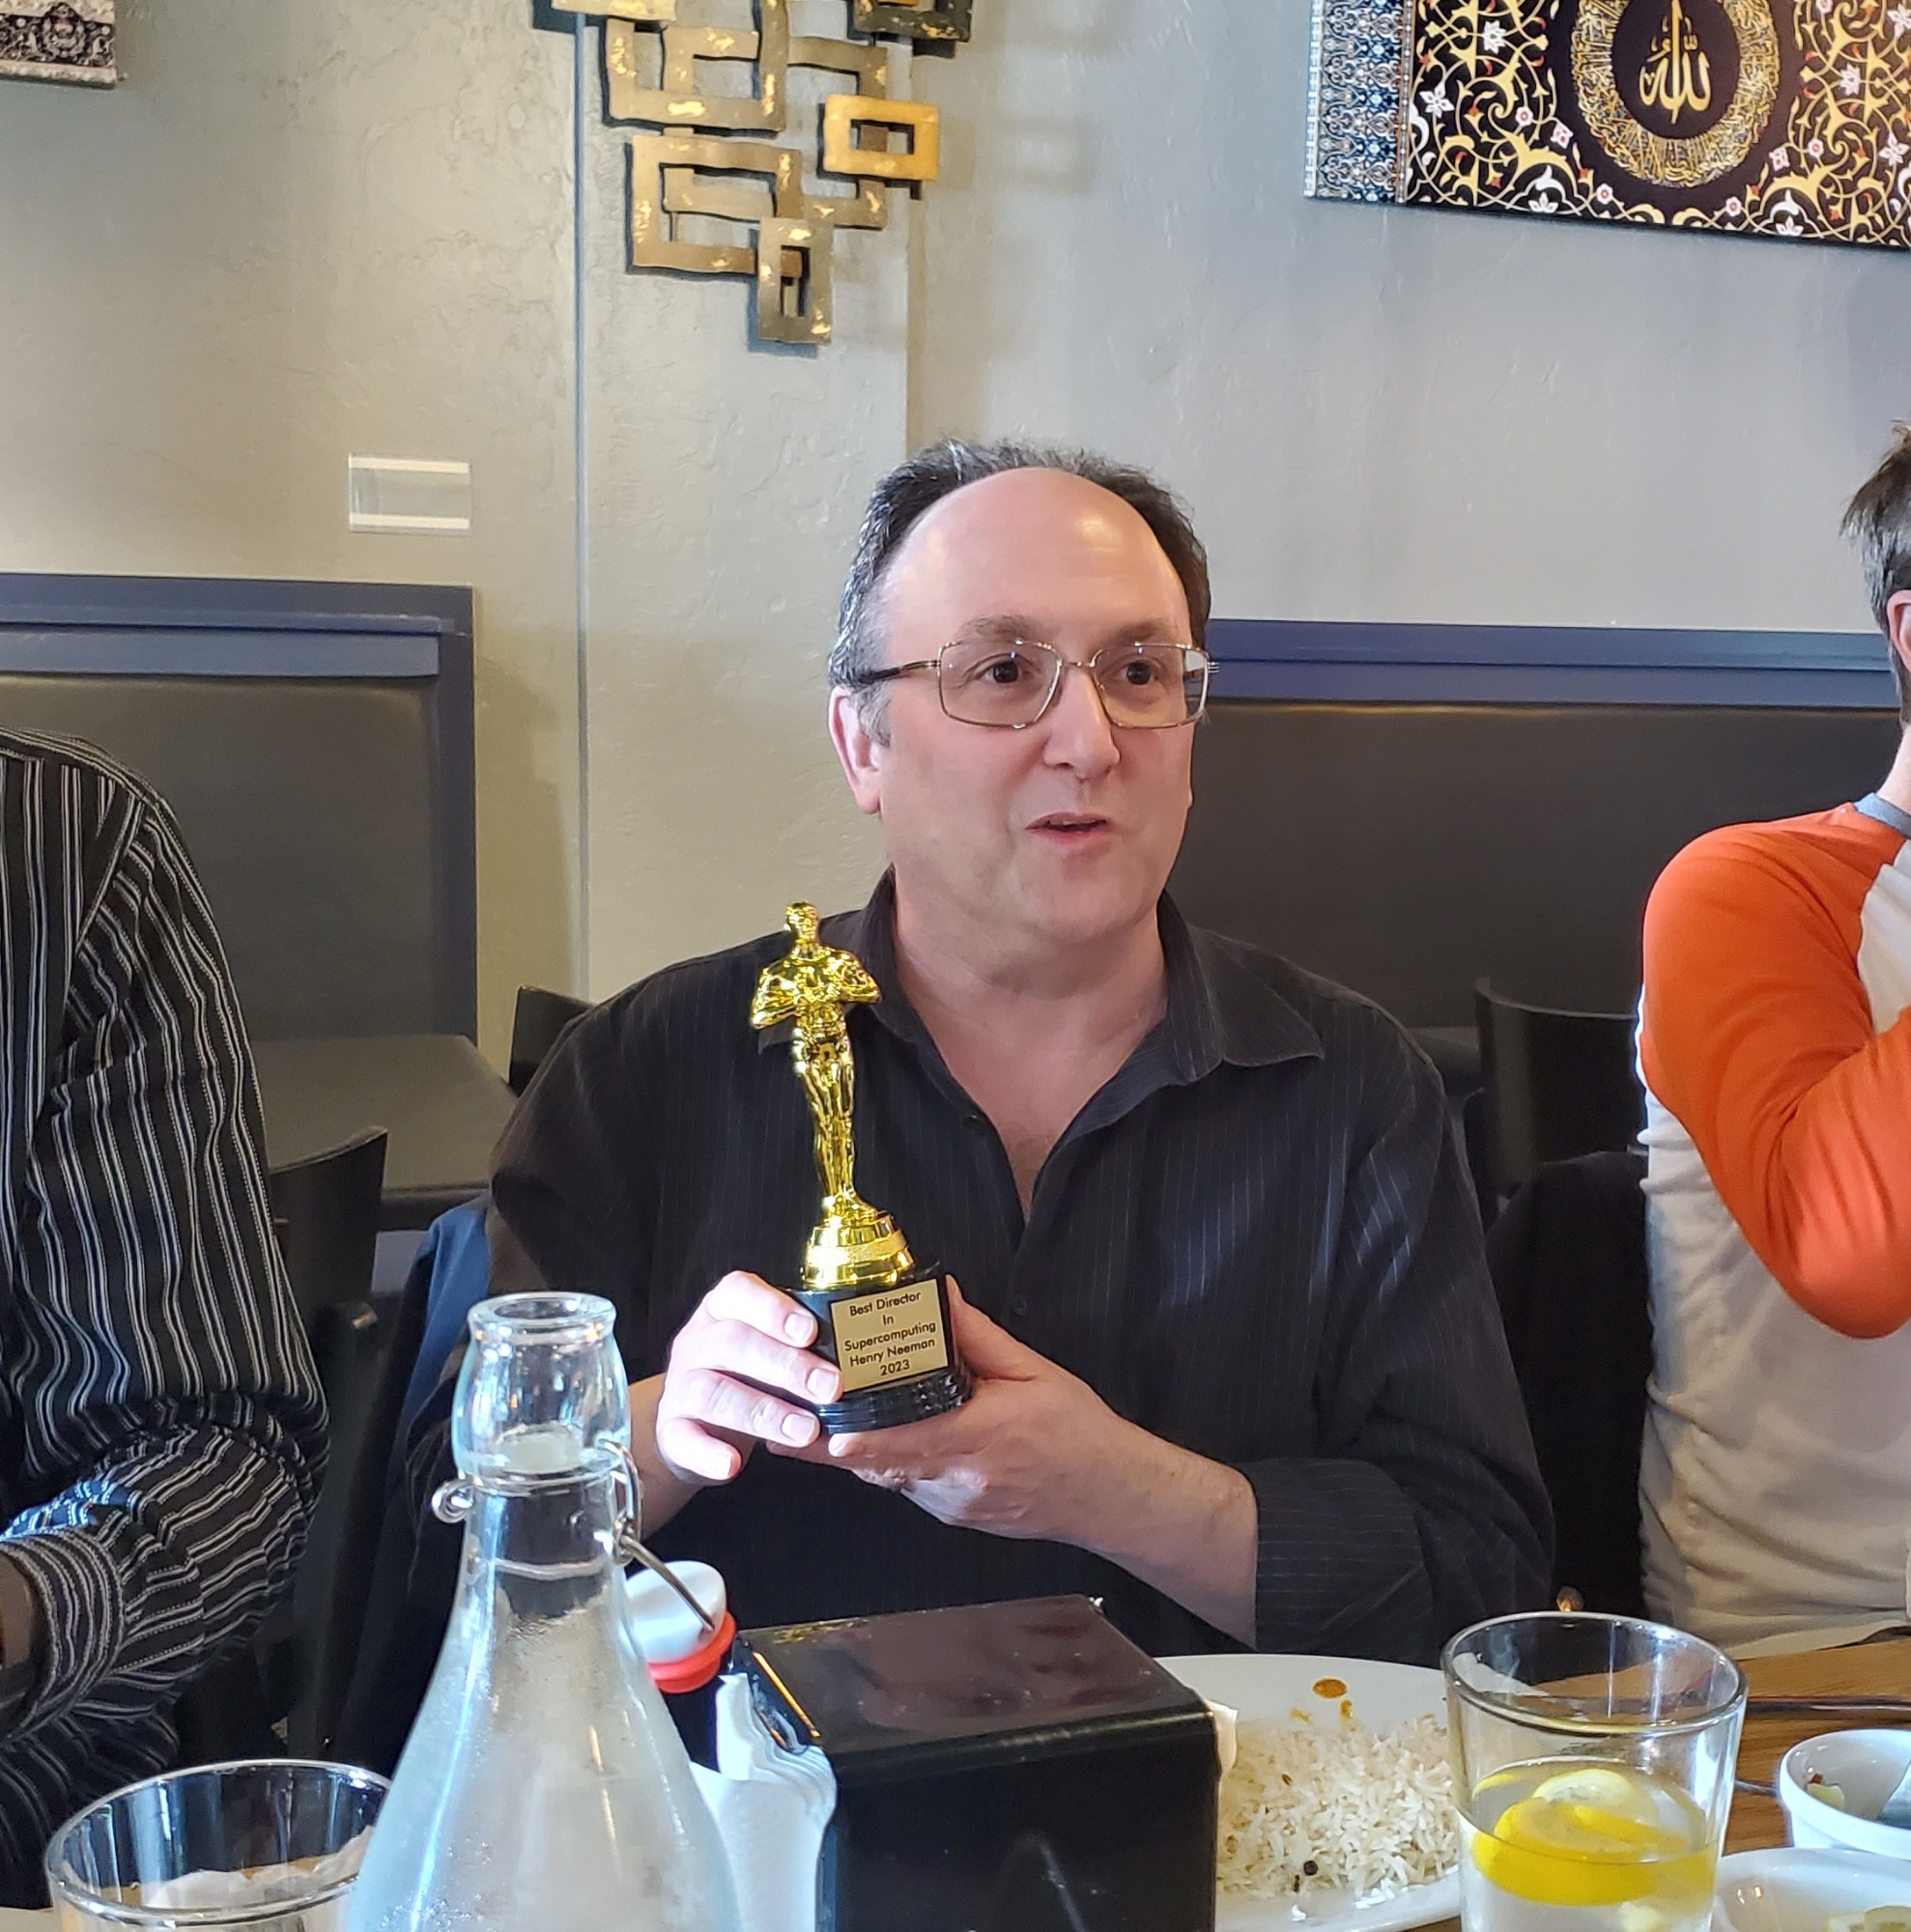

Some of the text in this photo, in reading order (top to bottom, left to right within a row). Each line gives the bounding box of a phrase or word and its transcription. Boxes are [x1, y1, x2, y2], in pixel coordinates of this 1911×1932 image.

[849, 1292, 922, 1317] Best Director
[882, 1314, 895, 1326] In
[843, 1321, 936, 1351] Supercomputing
[849, 1338, 935, 1367] Henry Neeman
[879, 1358, 911, 1377] 2023
